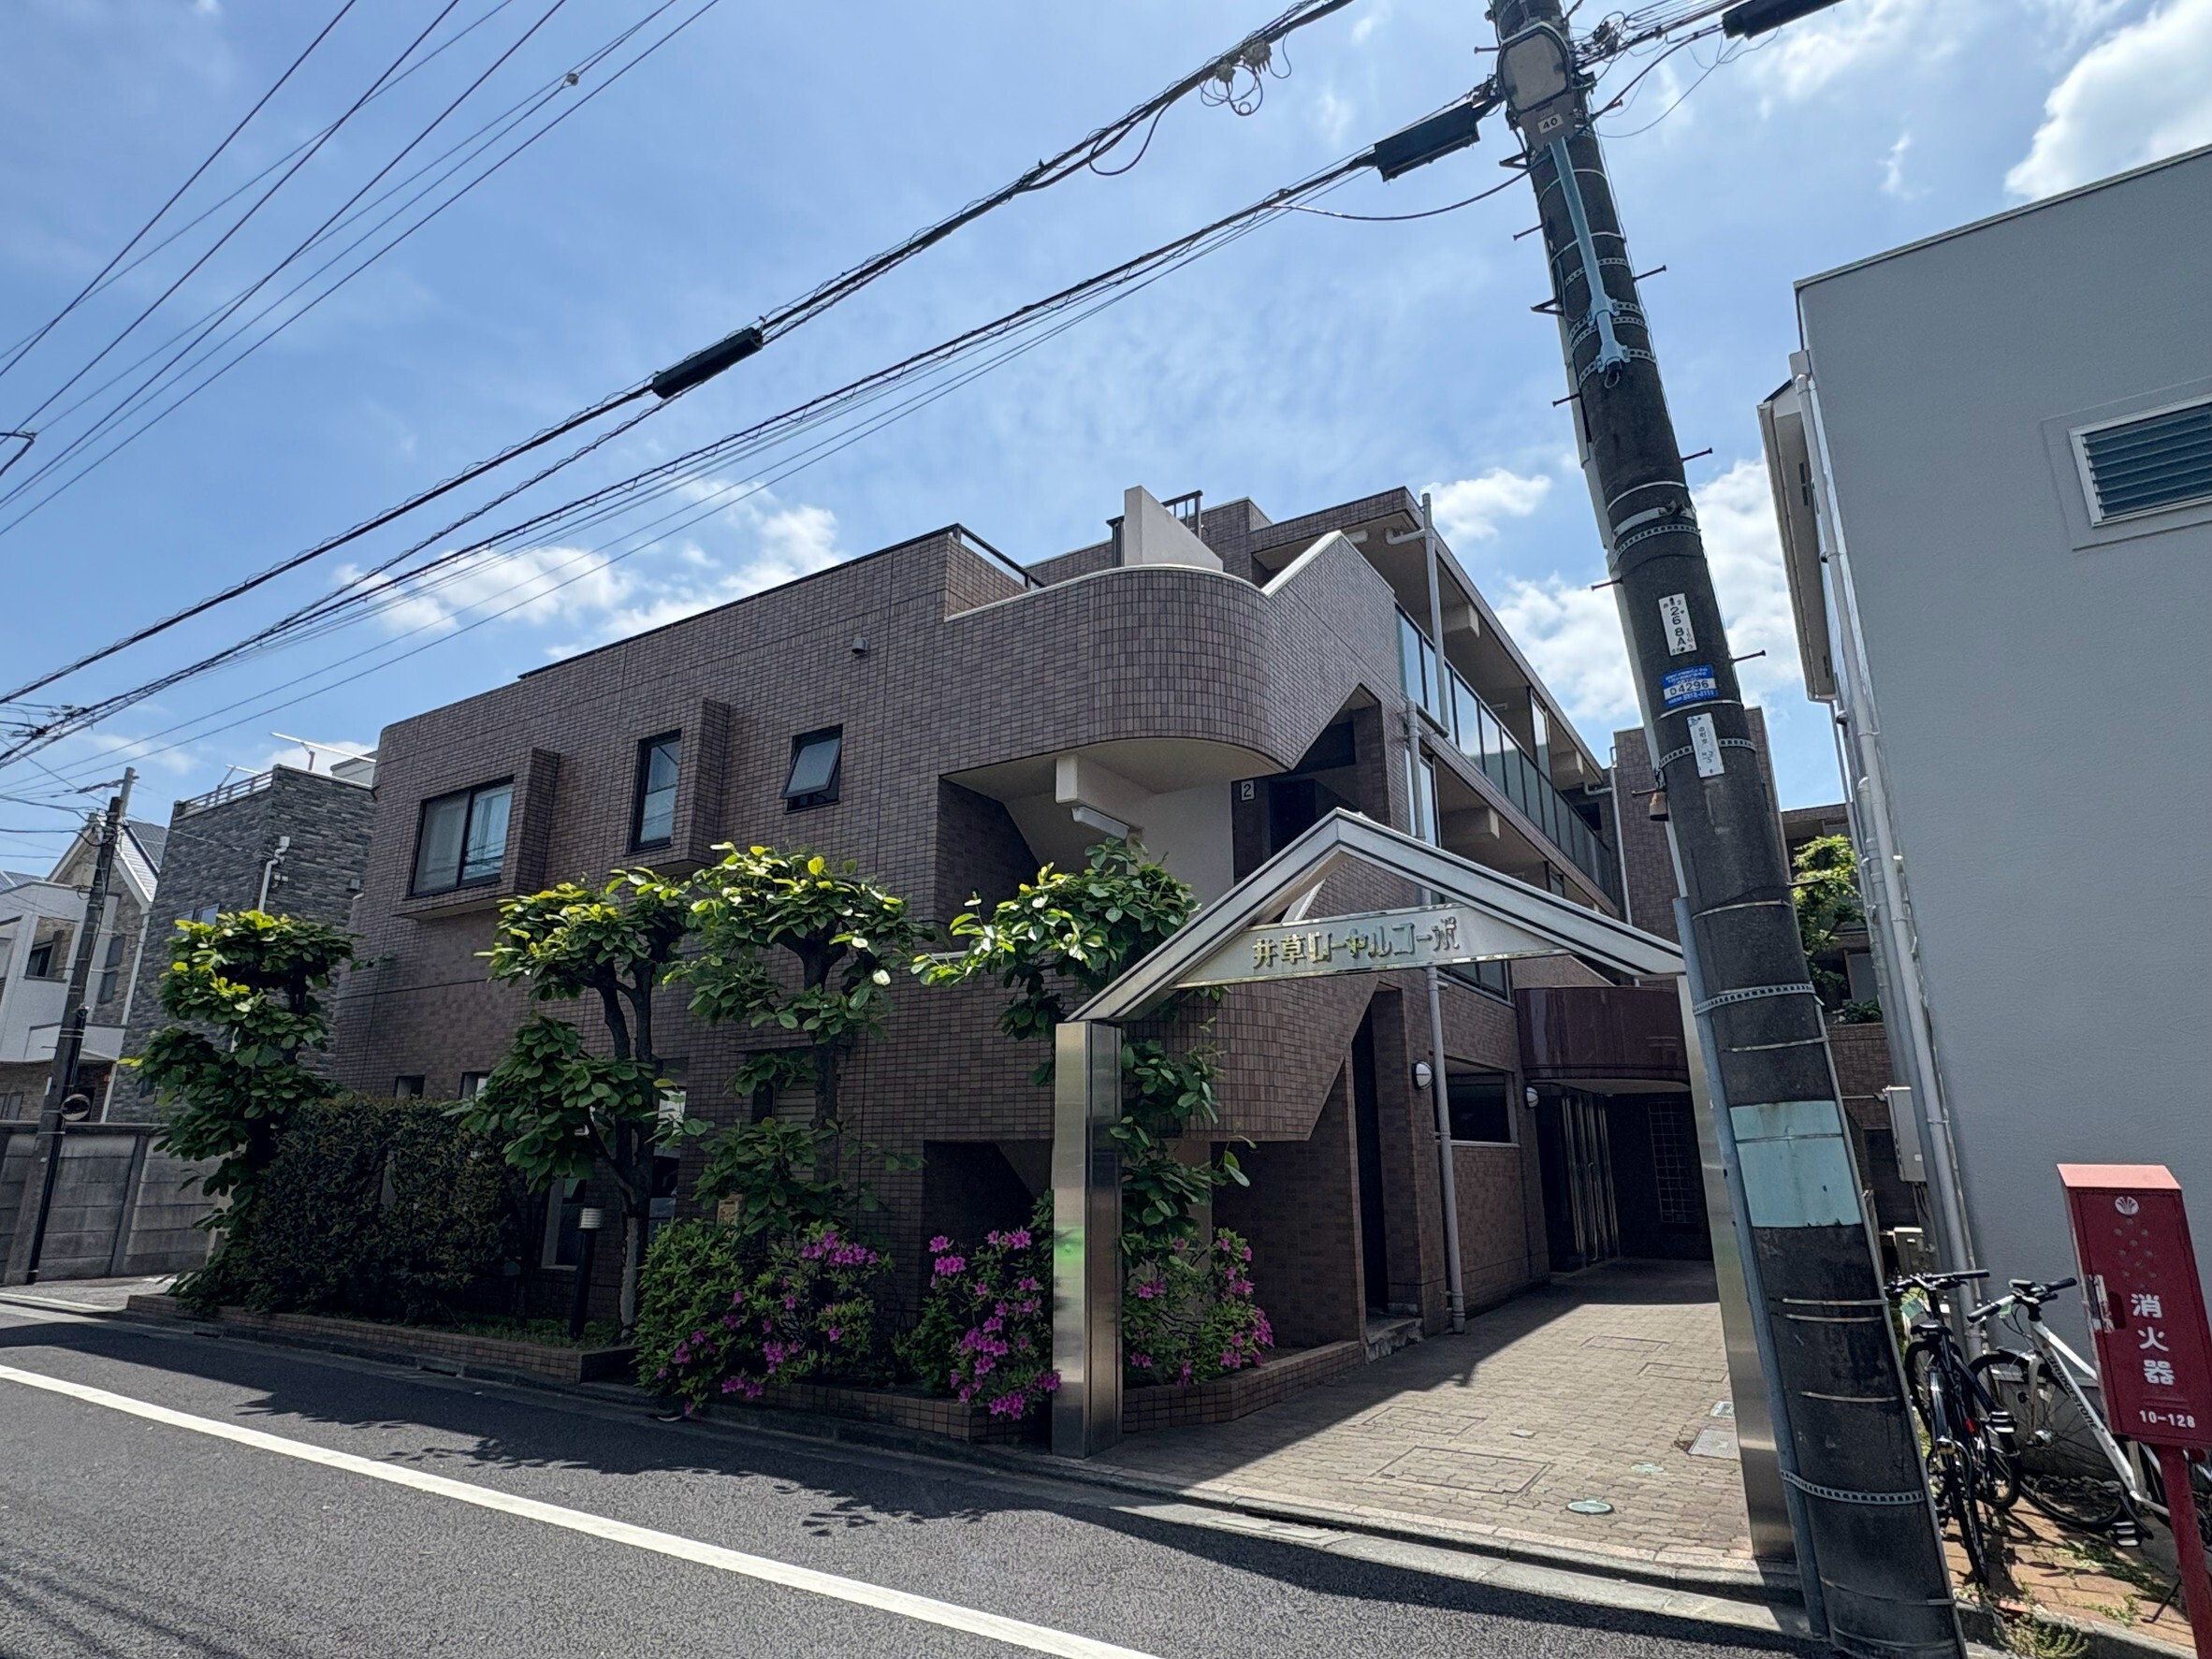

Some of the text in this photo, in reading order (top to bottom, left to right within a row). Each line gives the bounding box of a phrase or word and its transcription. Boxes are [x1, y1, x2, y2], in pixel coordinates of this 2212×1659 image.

[1543, 117, 1558, 130] 40
[1244, 783, 1252, 798] 2
[2131, 1293, 2176, 1386] 消火器
[2046, 1355, 2100, 1432] BRIDGESTONE
[2139, 1409, 2196, 1429] 10-128
